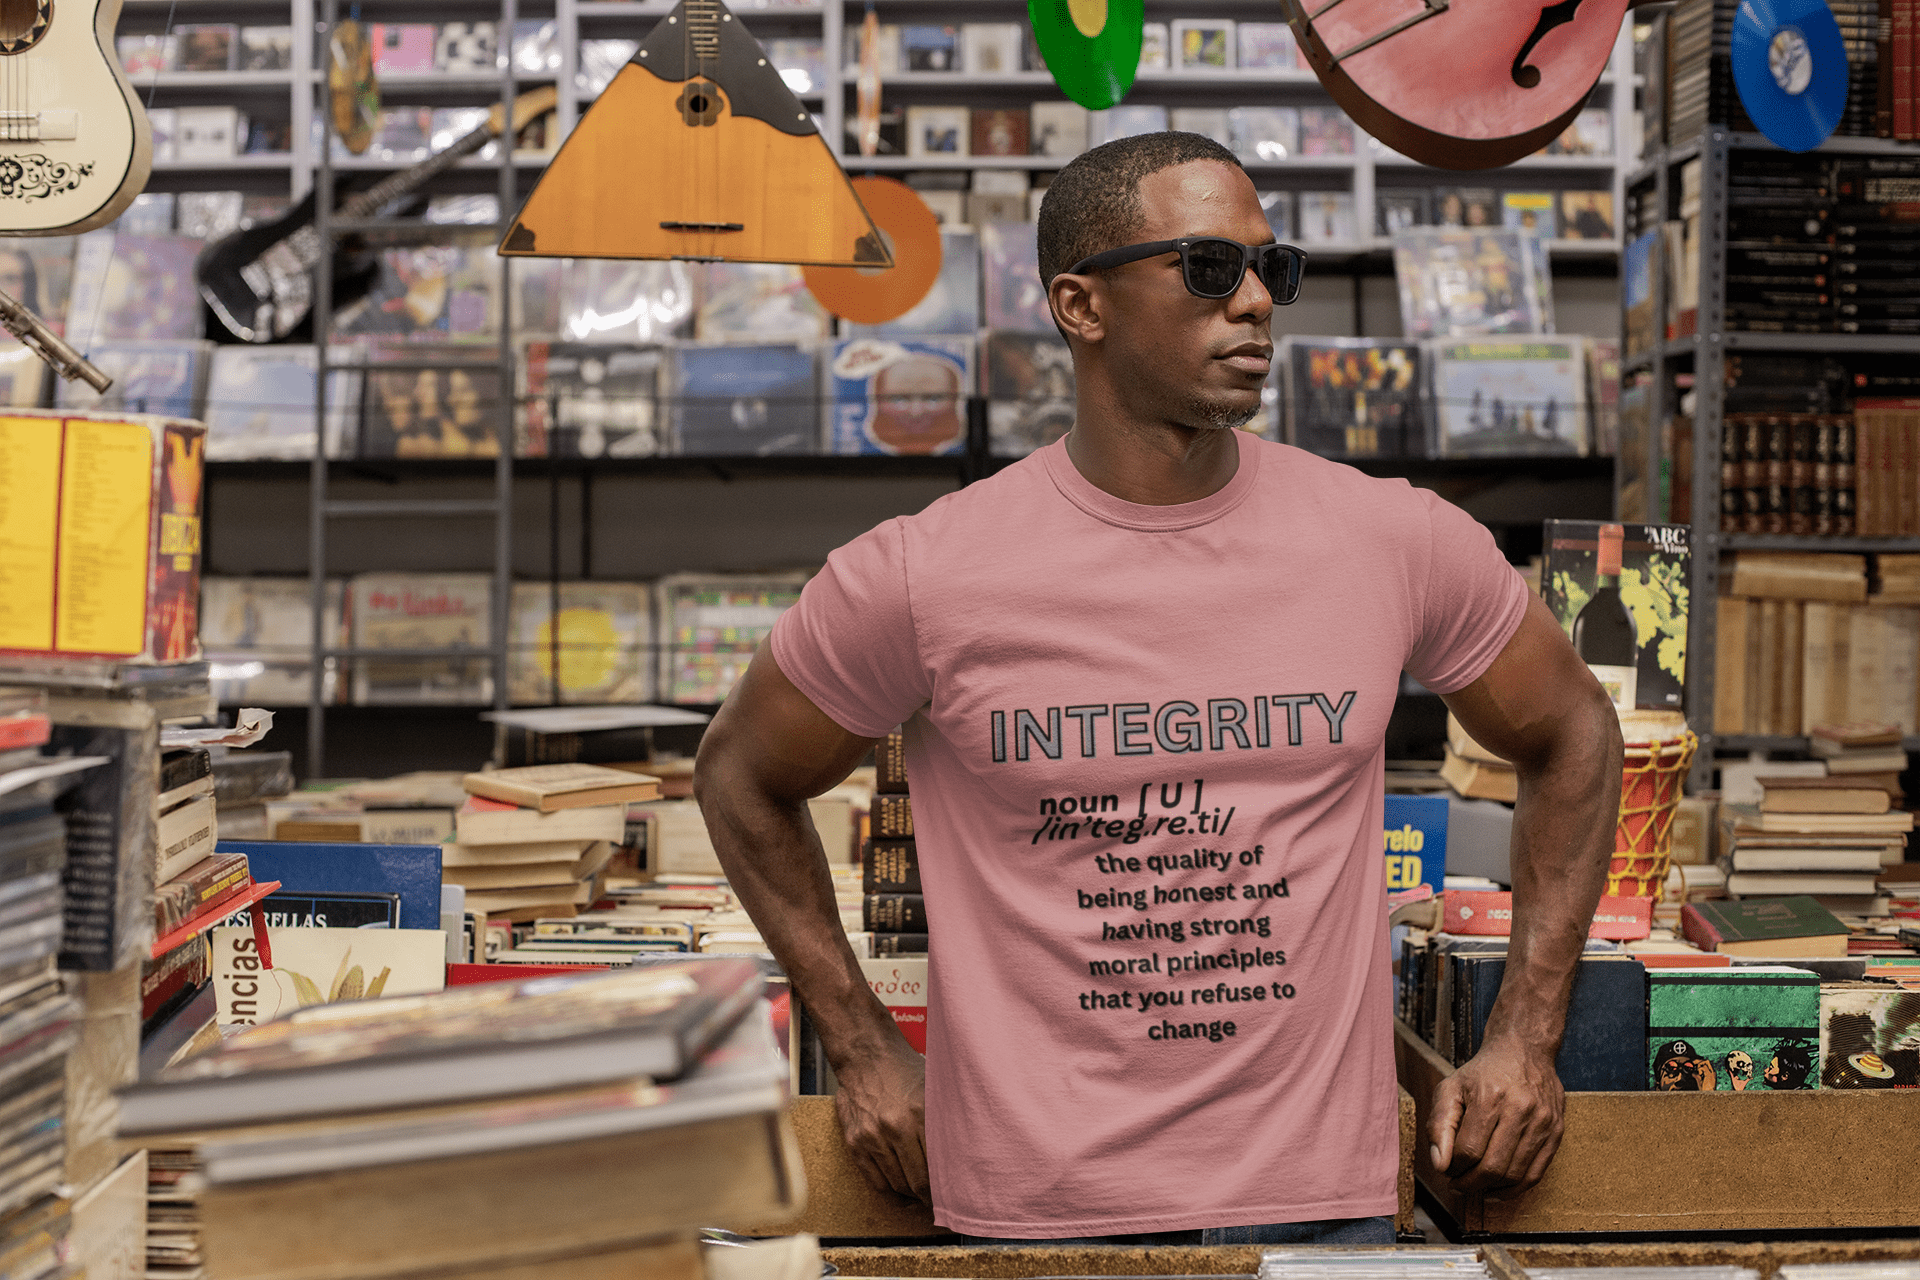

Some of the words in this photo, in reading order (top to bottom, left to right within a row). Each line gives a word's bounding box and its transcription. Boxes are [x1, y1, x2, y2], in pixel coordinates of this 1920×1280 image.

[1647, 526, 1686, 545] ABC
[989, 690, 1358, 763] INTEGRITY
[1039, 794, 1119, 815] noun
[1094, 852, 1141, 874] the
[1147, 848, 1233, 876] quality
[1239, 844, 1265, 866] of
[1077, 887, 1148, 911] being
[1153, 882, 1236, 905] honest
[1242, 877, 1291, 899] and
[1101, 918, 1186, 943] having
[1190, 915, 1272, 938] strong
[1088, 952, 1161, 977] moral
[1167, 946, 1287, 977] principles
[1078, 989, 1132, 1011] that
[1138, 989, 1184, 1013] you
[1191, 982, 1266, 1004] refuse
[1271, 981, 1296, 1000] to
[1147, 1019, 1237, 1043] change
